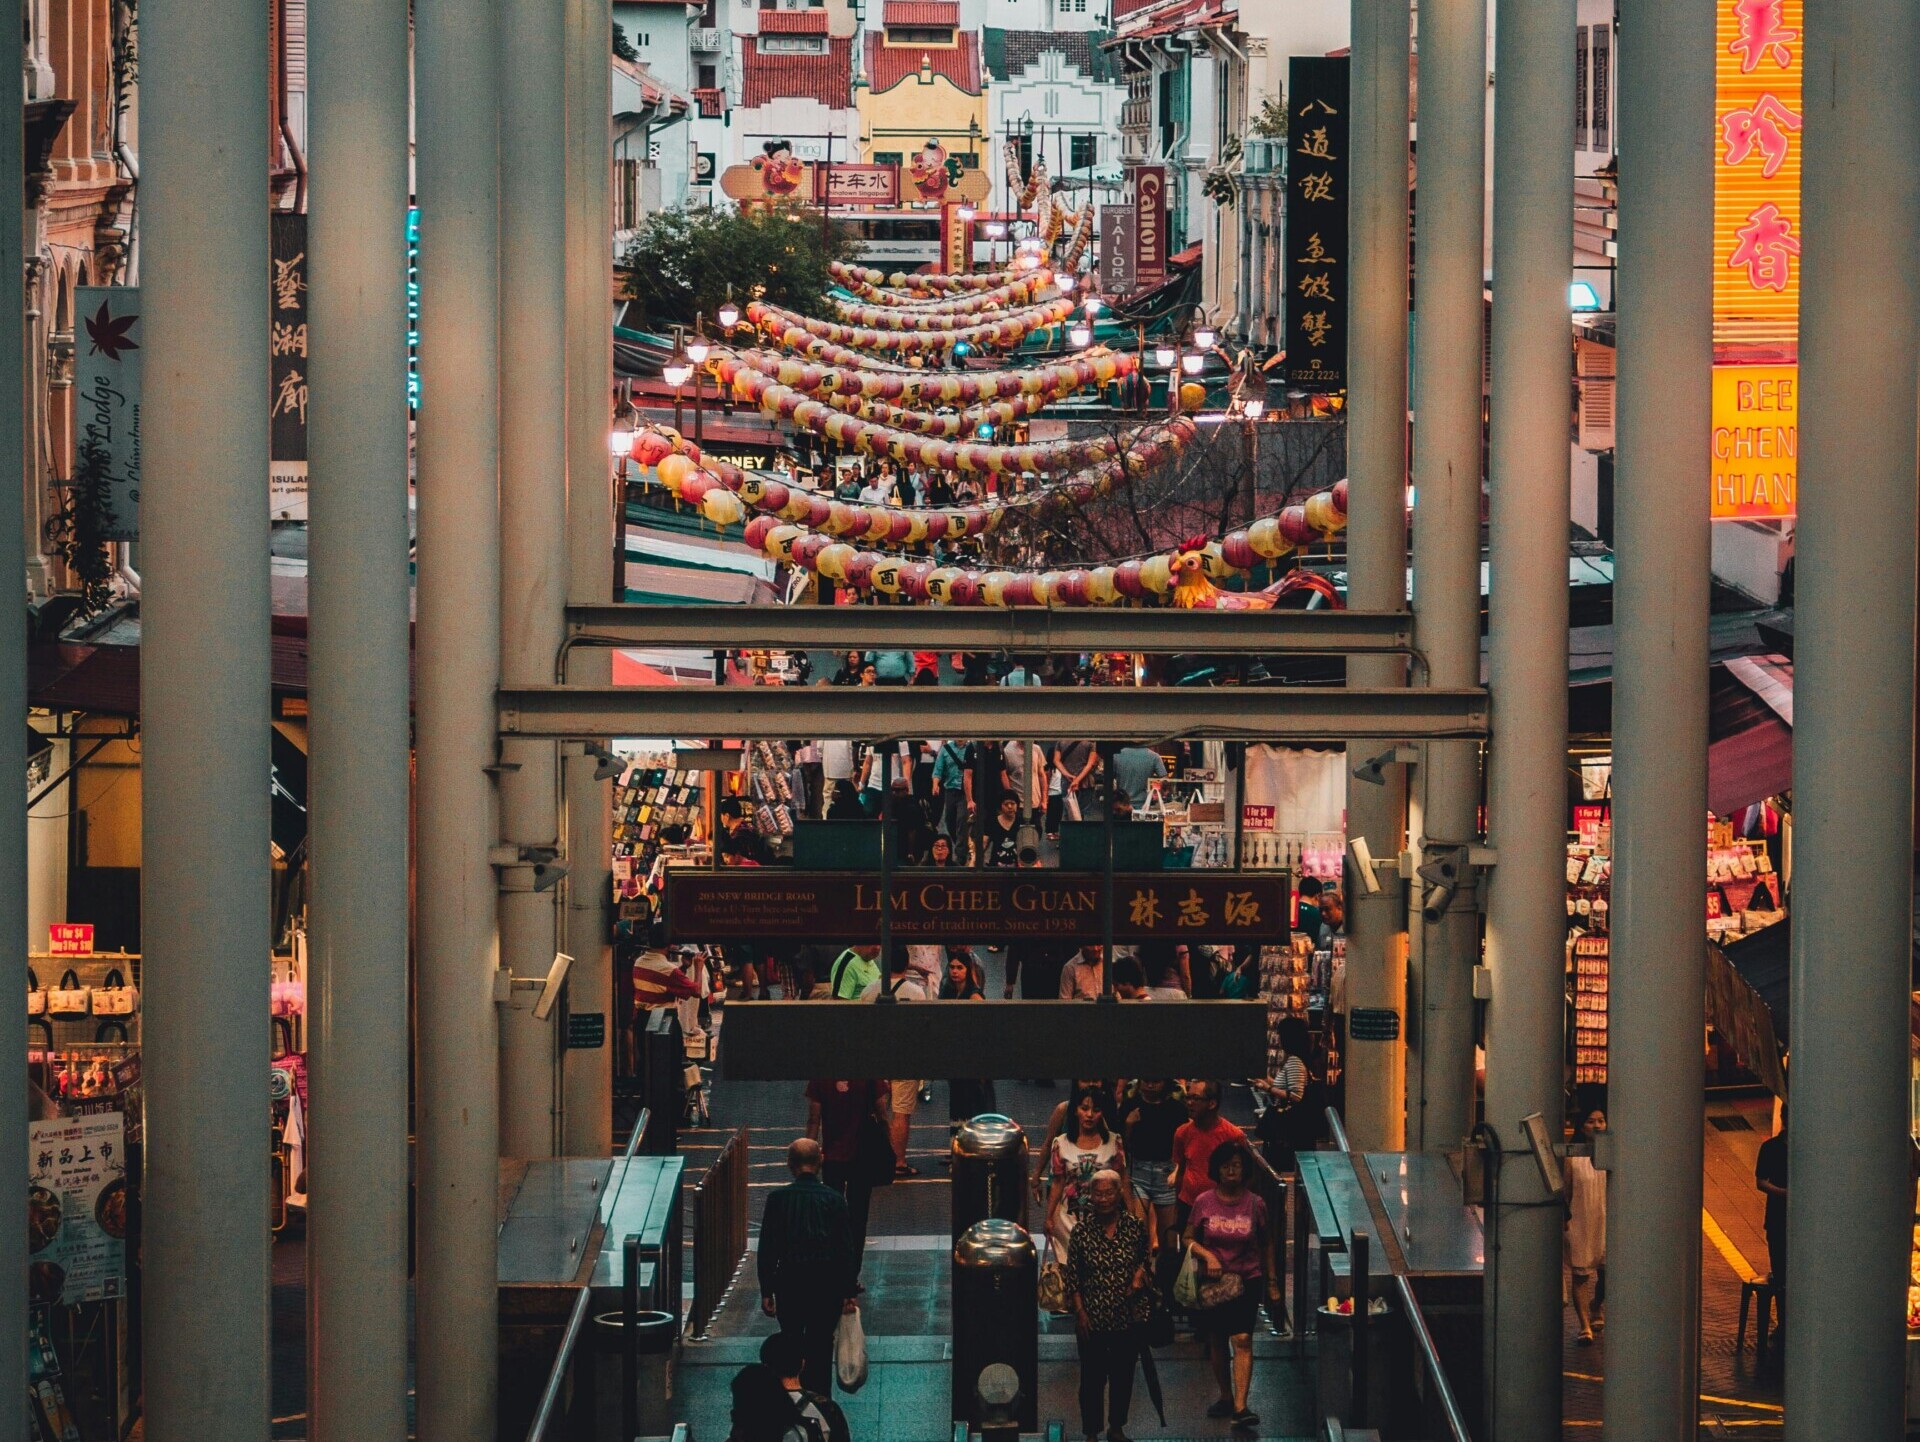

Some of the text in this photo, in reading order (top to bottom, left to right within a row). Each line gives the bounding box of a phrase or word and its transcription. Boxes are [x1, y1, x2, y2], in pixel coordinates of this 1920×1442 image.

[829, 172, 888, 189] 牛车水
[1140, 173, 1160, 262] Canon
[1112, 214, 1125, 278] TAILOR
[81, 376, 126, 444] Lodge
[1737, 380, 1793, 411] BEE
[718, 891, 742, 900] NEW
[744, 891, 782, 900] BRIDGE
[785, 891, 815, 900] ROAD
[1129, 888, 1262, 928] 林志源
[1707, 897, 1719, 916] $5
[922, 916, 938, 930] of
[1004, 917, 1040, 930] Since
[1043, 918, 1077, 930] 1938
[37, 1141, 114, 1168] 新品上市
